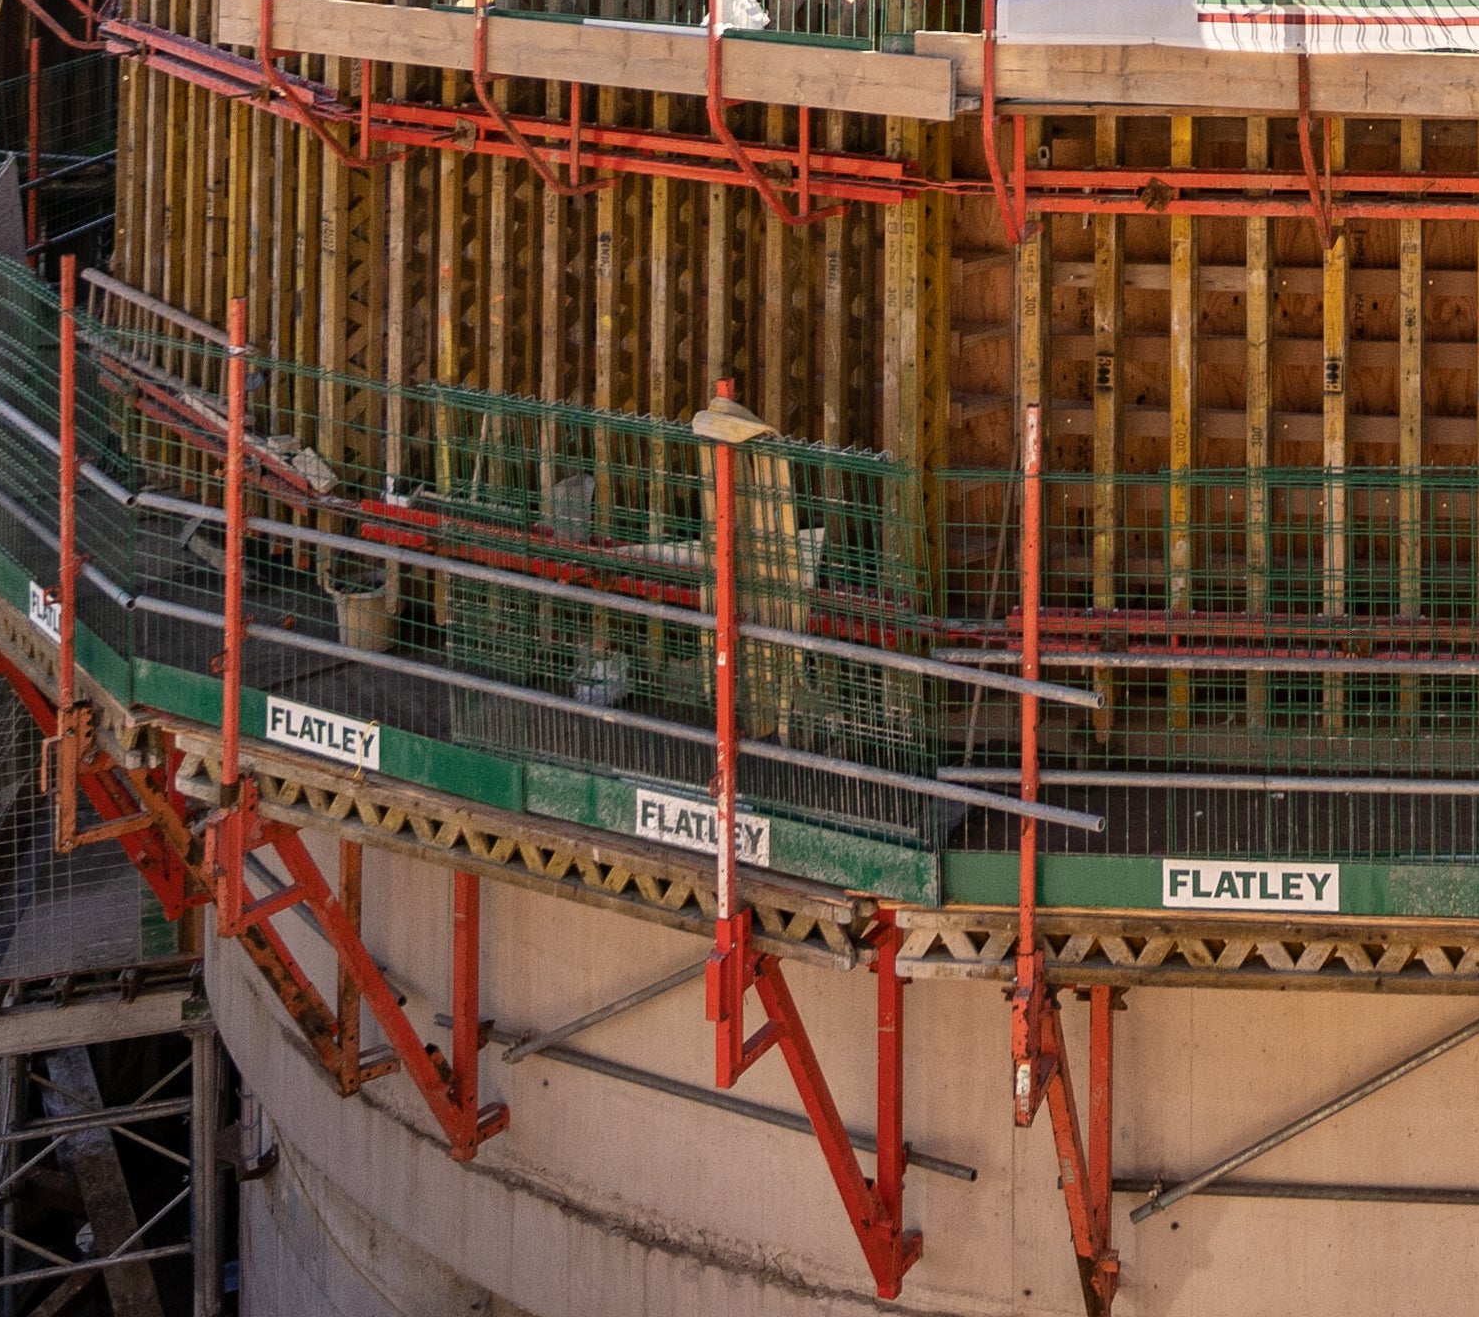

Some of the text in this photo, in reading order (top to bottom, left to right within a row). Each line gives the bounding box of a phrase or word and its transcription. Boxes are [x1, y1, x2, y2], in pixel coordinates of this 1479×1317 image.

[1024, 295, 1037, 317] 300
[1175, 431, 1188, 455] 300
[270, 705, 376, 759] FLATLEY
[1169, 869, 1332, 902] FLATLEY
